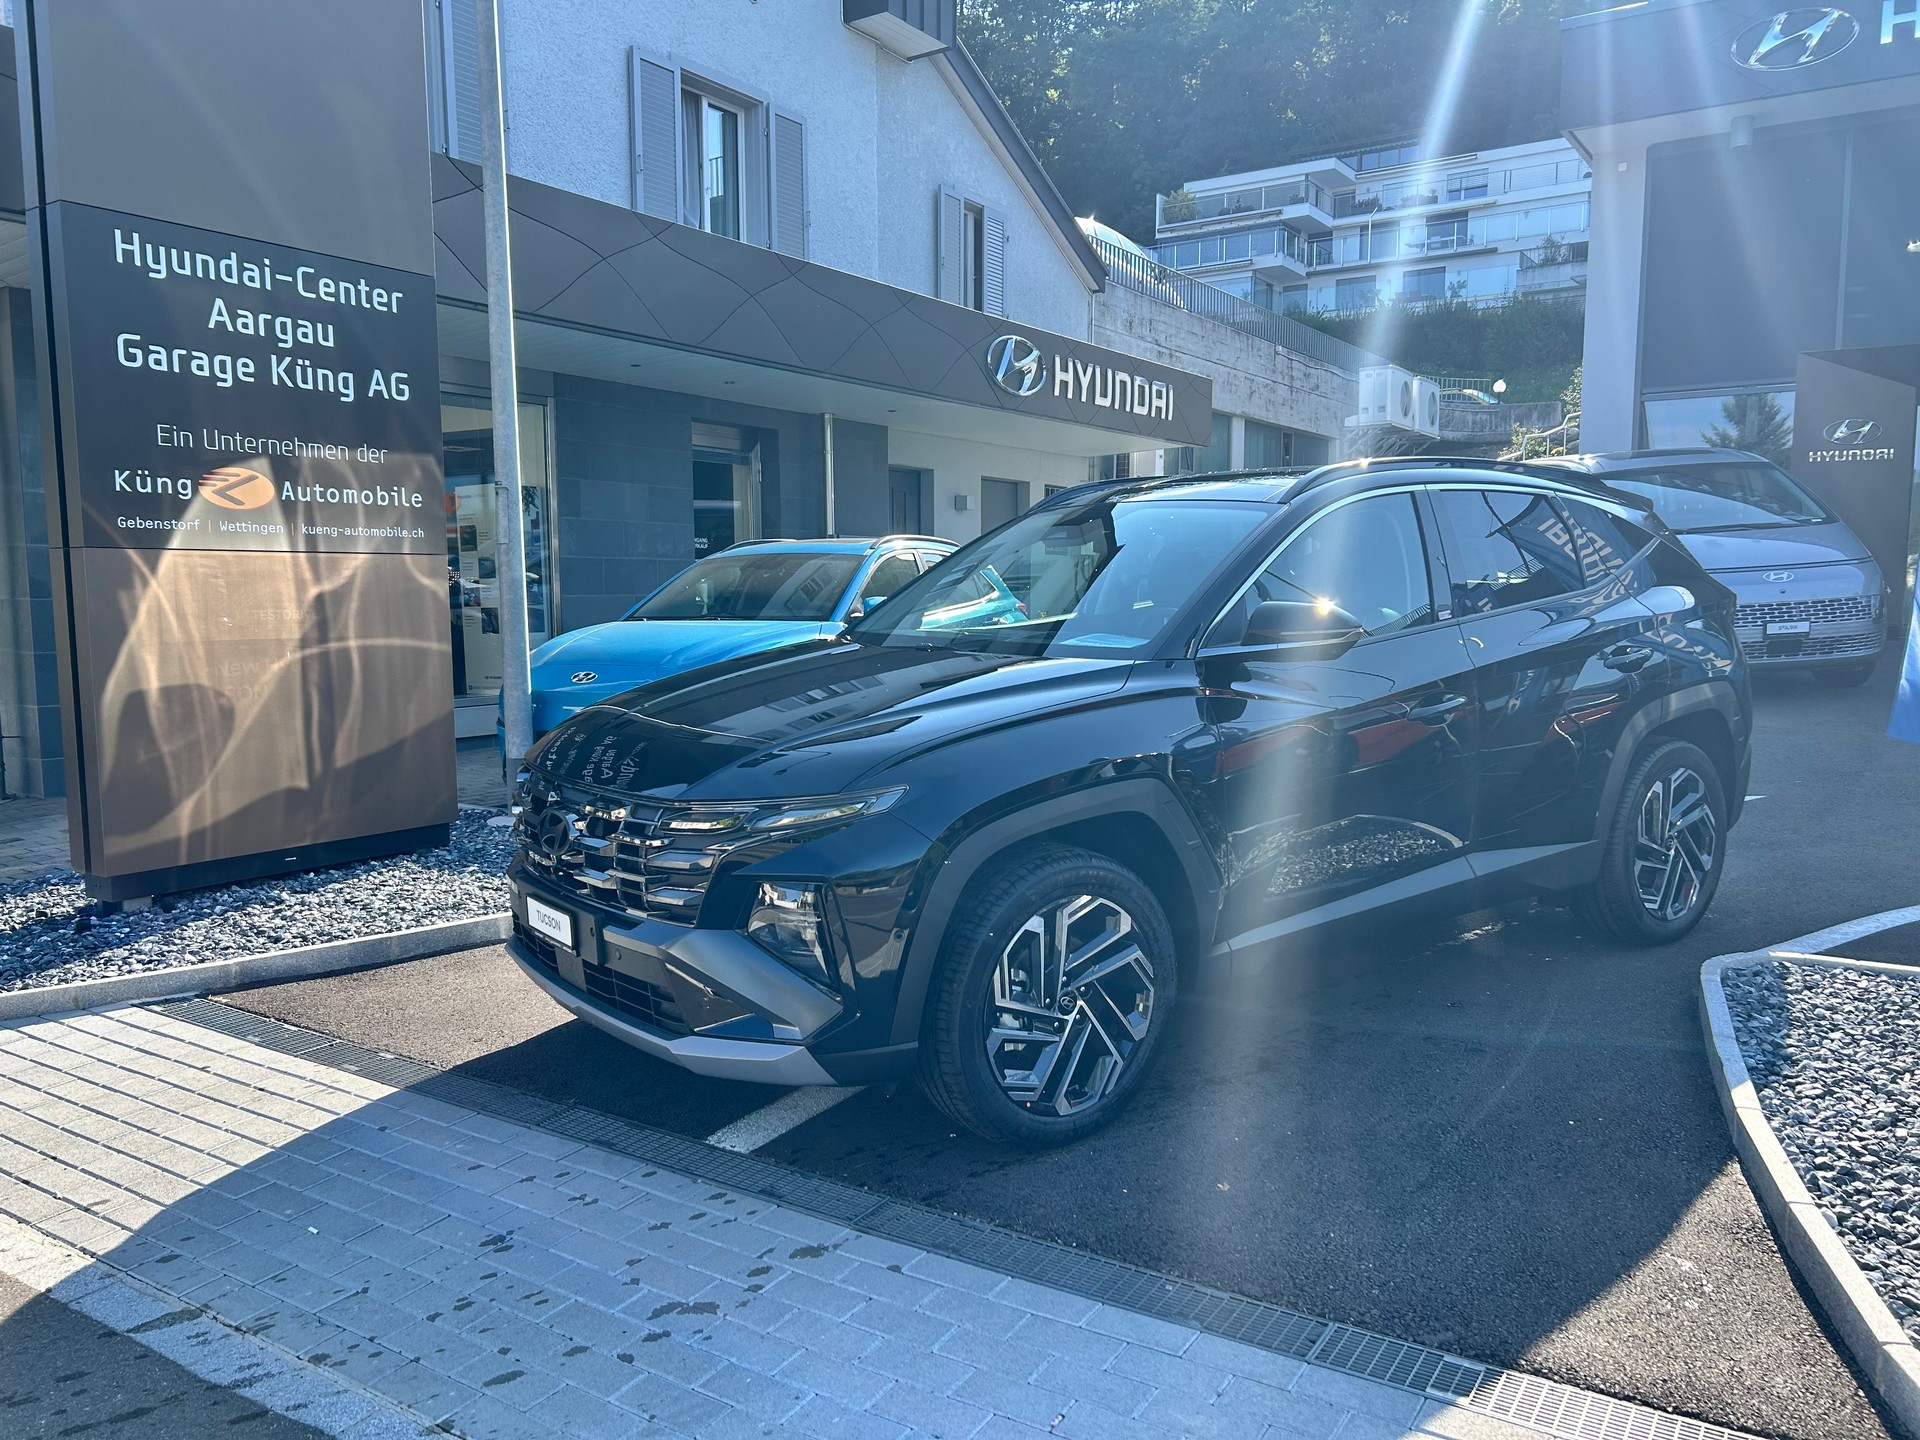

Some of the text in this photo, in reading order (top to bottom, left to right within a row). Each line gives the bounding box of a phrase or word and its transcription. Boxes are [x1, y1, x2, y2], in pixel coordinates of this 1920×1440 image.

[113, 228, 404, 314] Hyundai-Center
[207, 297, 335, 348] Aargau
[116, 332, 410, 402] Garage Küng AG
[1053, 354, 1174, 421] HYUNDAI
[156, 423, 389, 464] Ein Unternehmen der
[1808, 448, 1895, 463] HYUNDAI
[114, 469, 423, 509] Küng Automobile
[117, 516, 425, 540] Gebenstorf Wettingen kueng-automobile.ch
[536, 908, 562, 932] TUCSON
